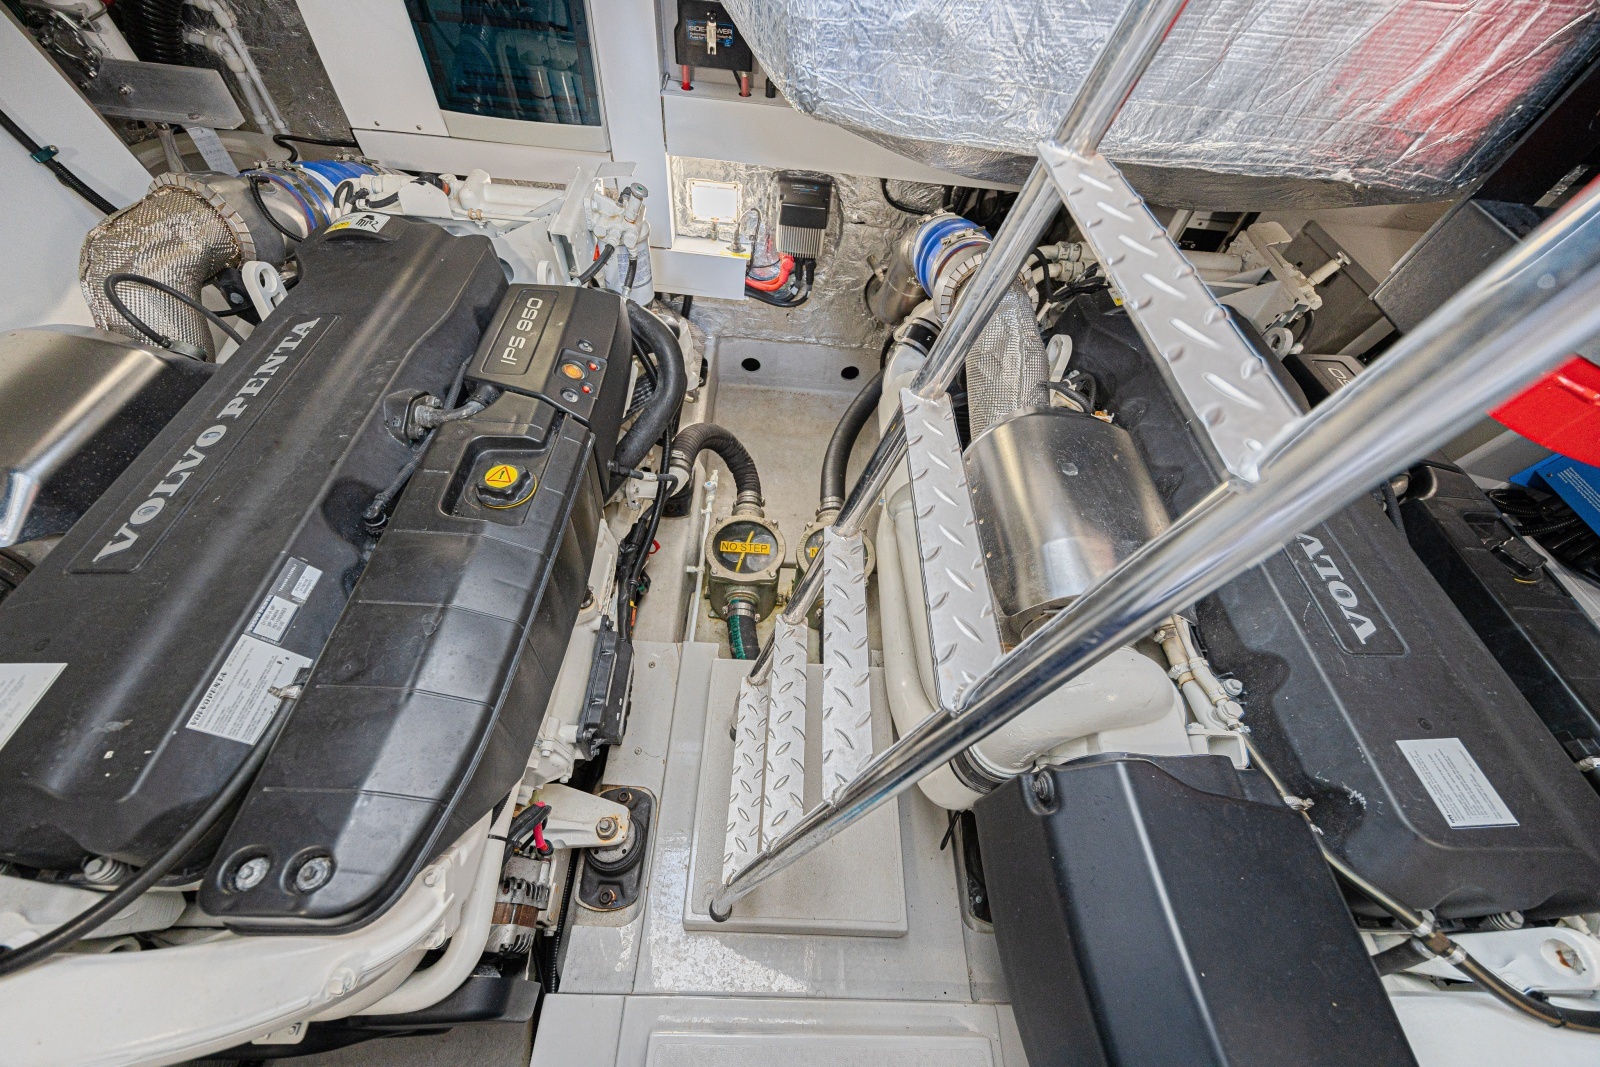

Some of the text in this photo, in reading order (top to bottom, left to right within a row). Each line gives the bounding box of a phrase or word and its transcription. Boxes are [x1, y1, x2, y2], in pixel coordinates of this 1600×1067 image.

[500, 297, 543, 365] IPS 950
[92, 317, 321, 563] VOLVO PENTA
[721, 542, 768, 553] NO STEP
[1295, 533, 1377, 645] VOLV
